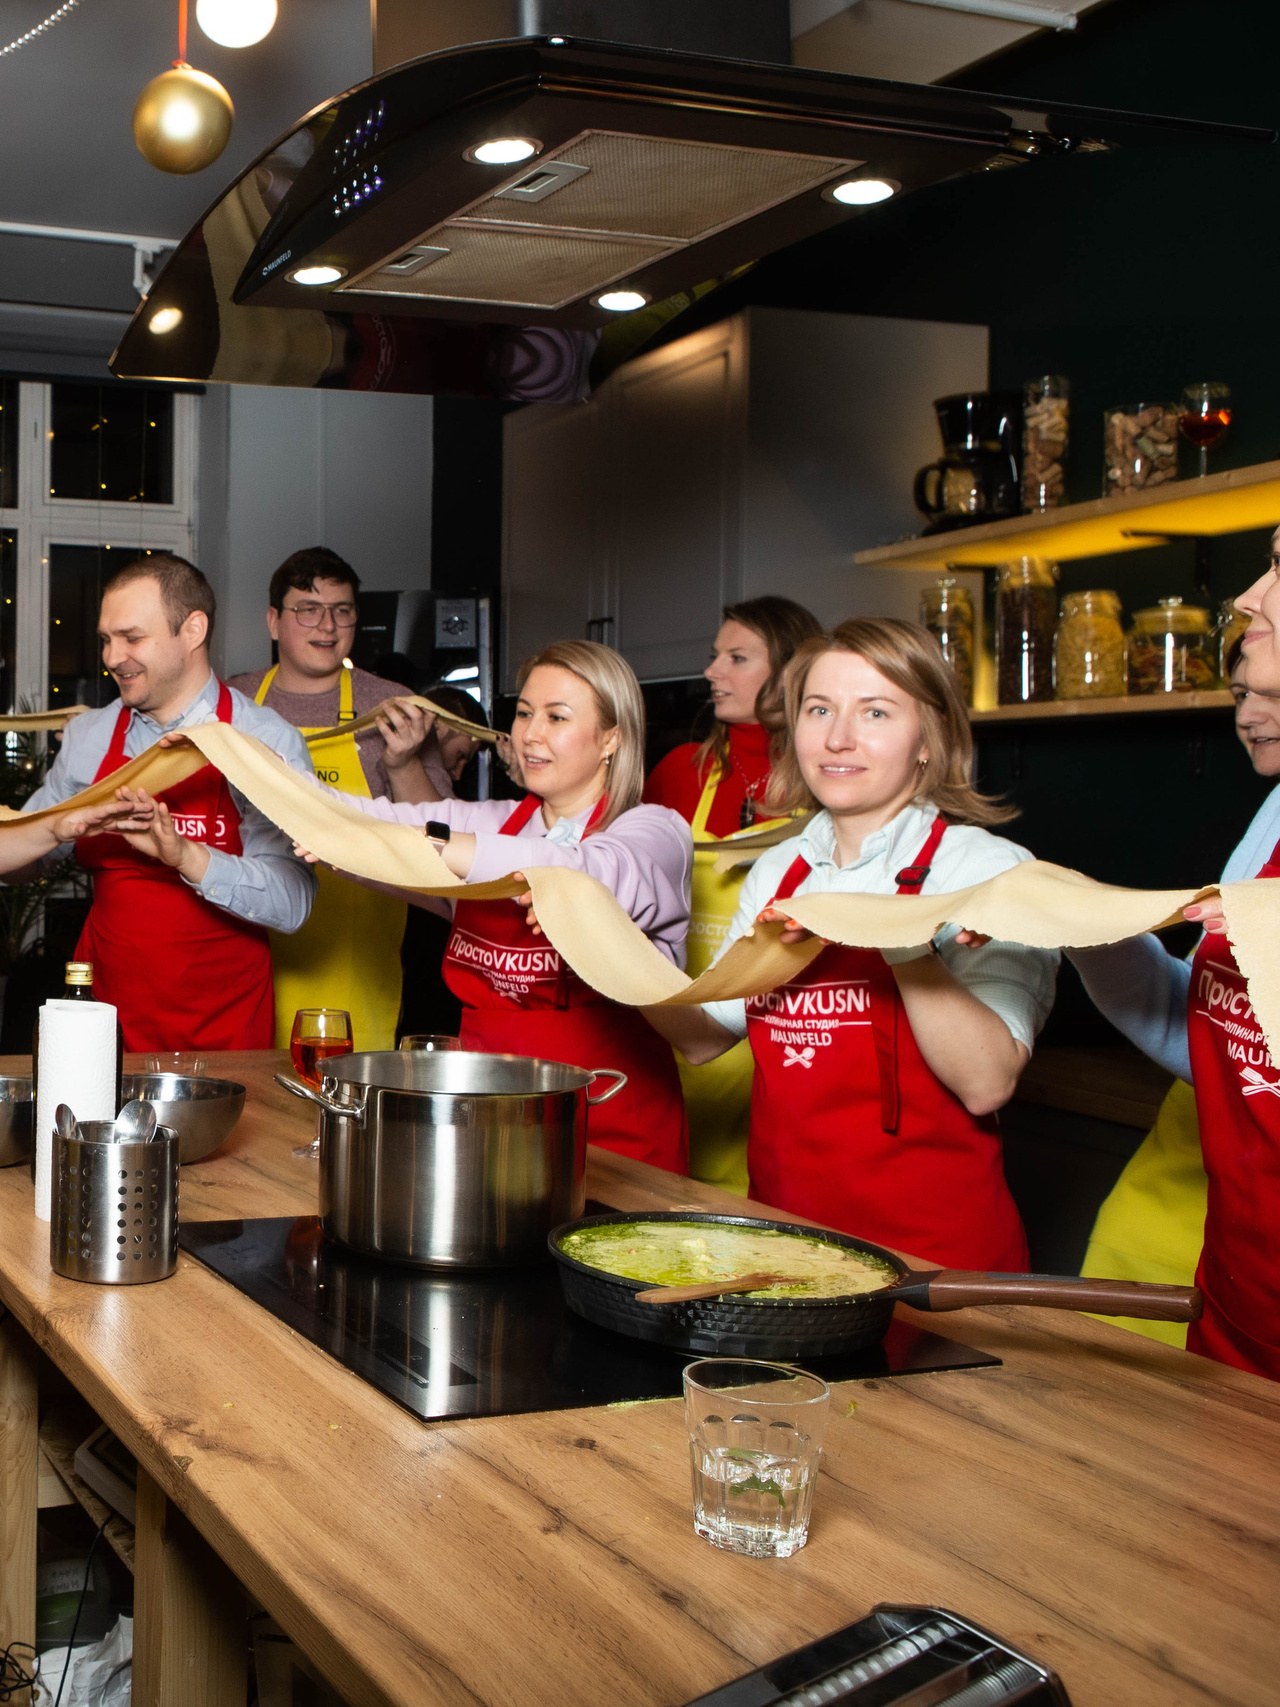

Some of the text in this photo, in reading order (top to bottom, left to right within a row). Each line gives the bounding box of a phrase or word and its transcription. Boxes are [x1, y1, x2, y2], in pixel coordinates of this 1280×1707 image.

[172, 818, 226, 837] USNO
[746, 988, 870, 1015] ростоVKUSN
[804, 1018, 840, 1031] СТУДИЯ
[770, 1028, 832, 1047] MAUNFELD
